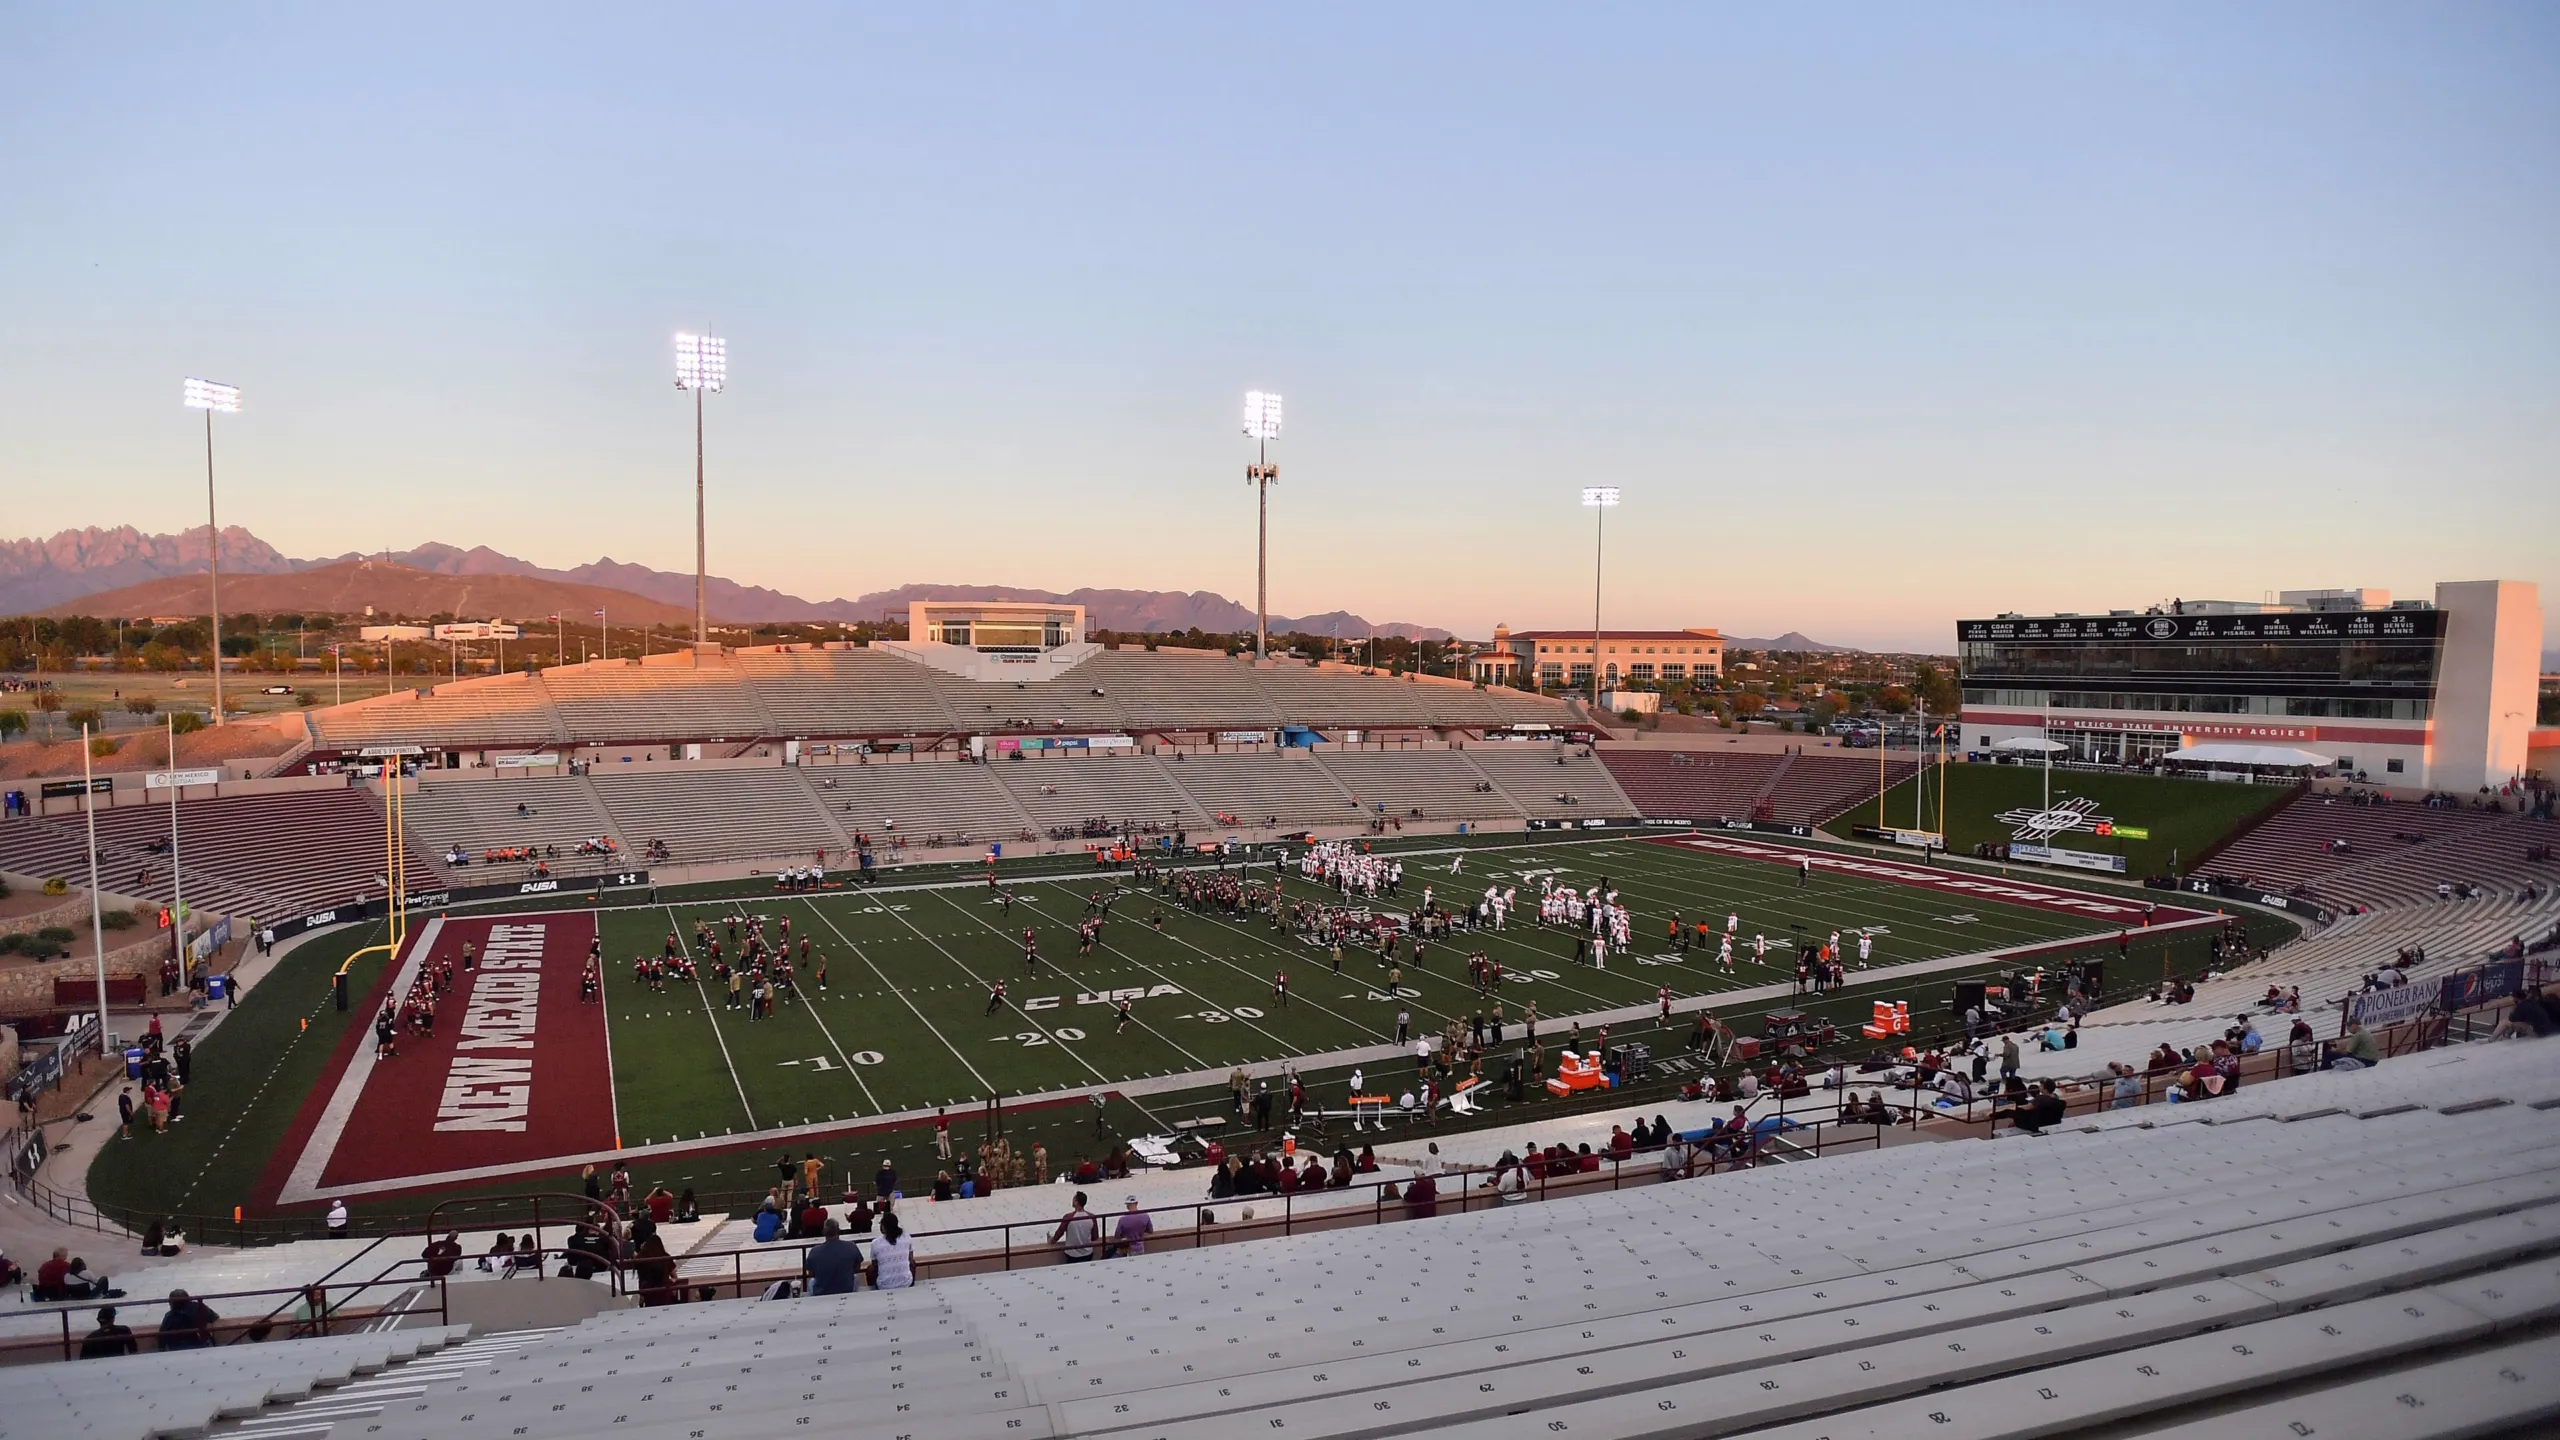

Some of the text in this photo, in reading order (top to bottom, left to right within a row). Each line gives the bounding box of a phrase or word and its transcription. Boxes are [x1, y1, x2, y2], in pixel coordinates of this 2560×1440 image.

[2074, 720, 2114, 728] MEXICO
[2122, 722, 2153, 730] STATE
[2164, 724, 2243, 735] UNIVERSITY
[2250, 728, 2306, 737] AGGIES
[2096, 824, 2112, 836] 25
[405, 896, 422, 905] First
[1502, 969, 1560, 984] 50
[2477, 969, 2506, 996] pepsi
[2366, 980, 2440, 1013] PIONEER BANK
[1198, 1006, 1265, 1024] 30
[433, 924, 546, 1132] NEW MEXICO STATE
[1893, 1019, 1901, 1031] G
[1015, 1028, 1086, 1047] 20
[804, 1050, 885, 1072] 10
[1948, 1344, 1965, 1352] 26
[1859, 1361, 1875, 1371] 27
[2137, 1366, 2159, 1376] 26
[1480, 1384, 1494, 1392] 29
[1760, 1381, 1779, 1390] 28
[2037, 1388, 2058, 1399] 27
[1374, 1402, 1390, 1410] 30
[1658, 1401, 1676, 1410] 29
[461, 1414, 475, 1422] 39
[613, 1415, 627, 1423] 37
[796, 1417, 809, 1425] 35
[1929, 1412, 1951, 1423] 28
[1007, 1420, 1021, 1428] 33
[1270, 1419, 1284, 1428] 31
[1548, 1421, 1567, 1431] 30
[690, 1430, 704, 1438] 36
